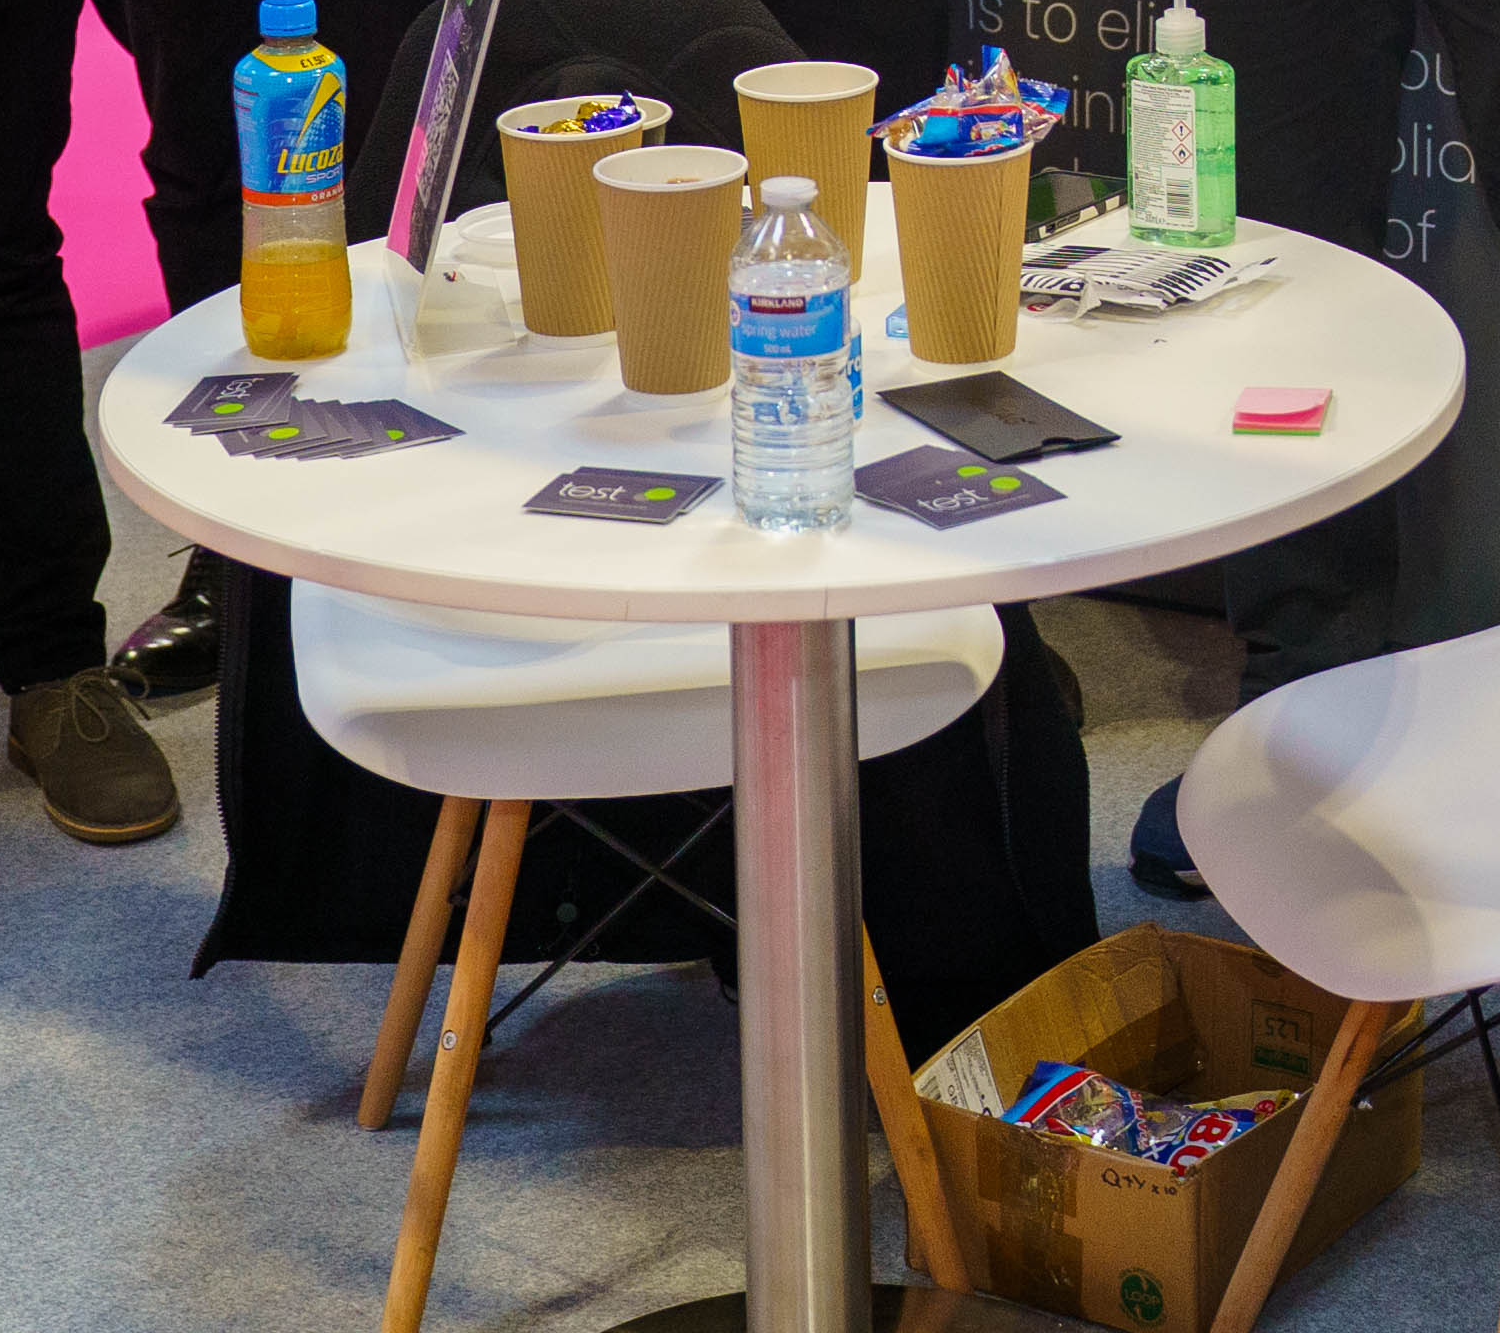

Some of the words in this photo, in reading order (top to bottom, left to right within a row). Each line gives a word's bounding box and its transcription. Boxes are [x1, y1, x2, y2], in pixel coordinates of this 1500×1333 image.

[1097, 0, 1155, 53] eli
[751, 298, 804, 309] KIRKLAND
[742, 325, 777, 340] spring
[780, 324, 816, 337] water
[559, 480, 626, 502] test
[917, 487, 989, 512] test
